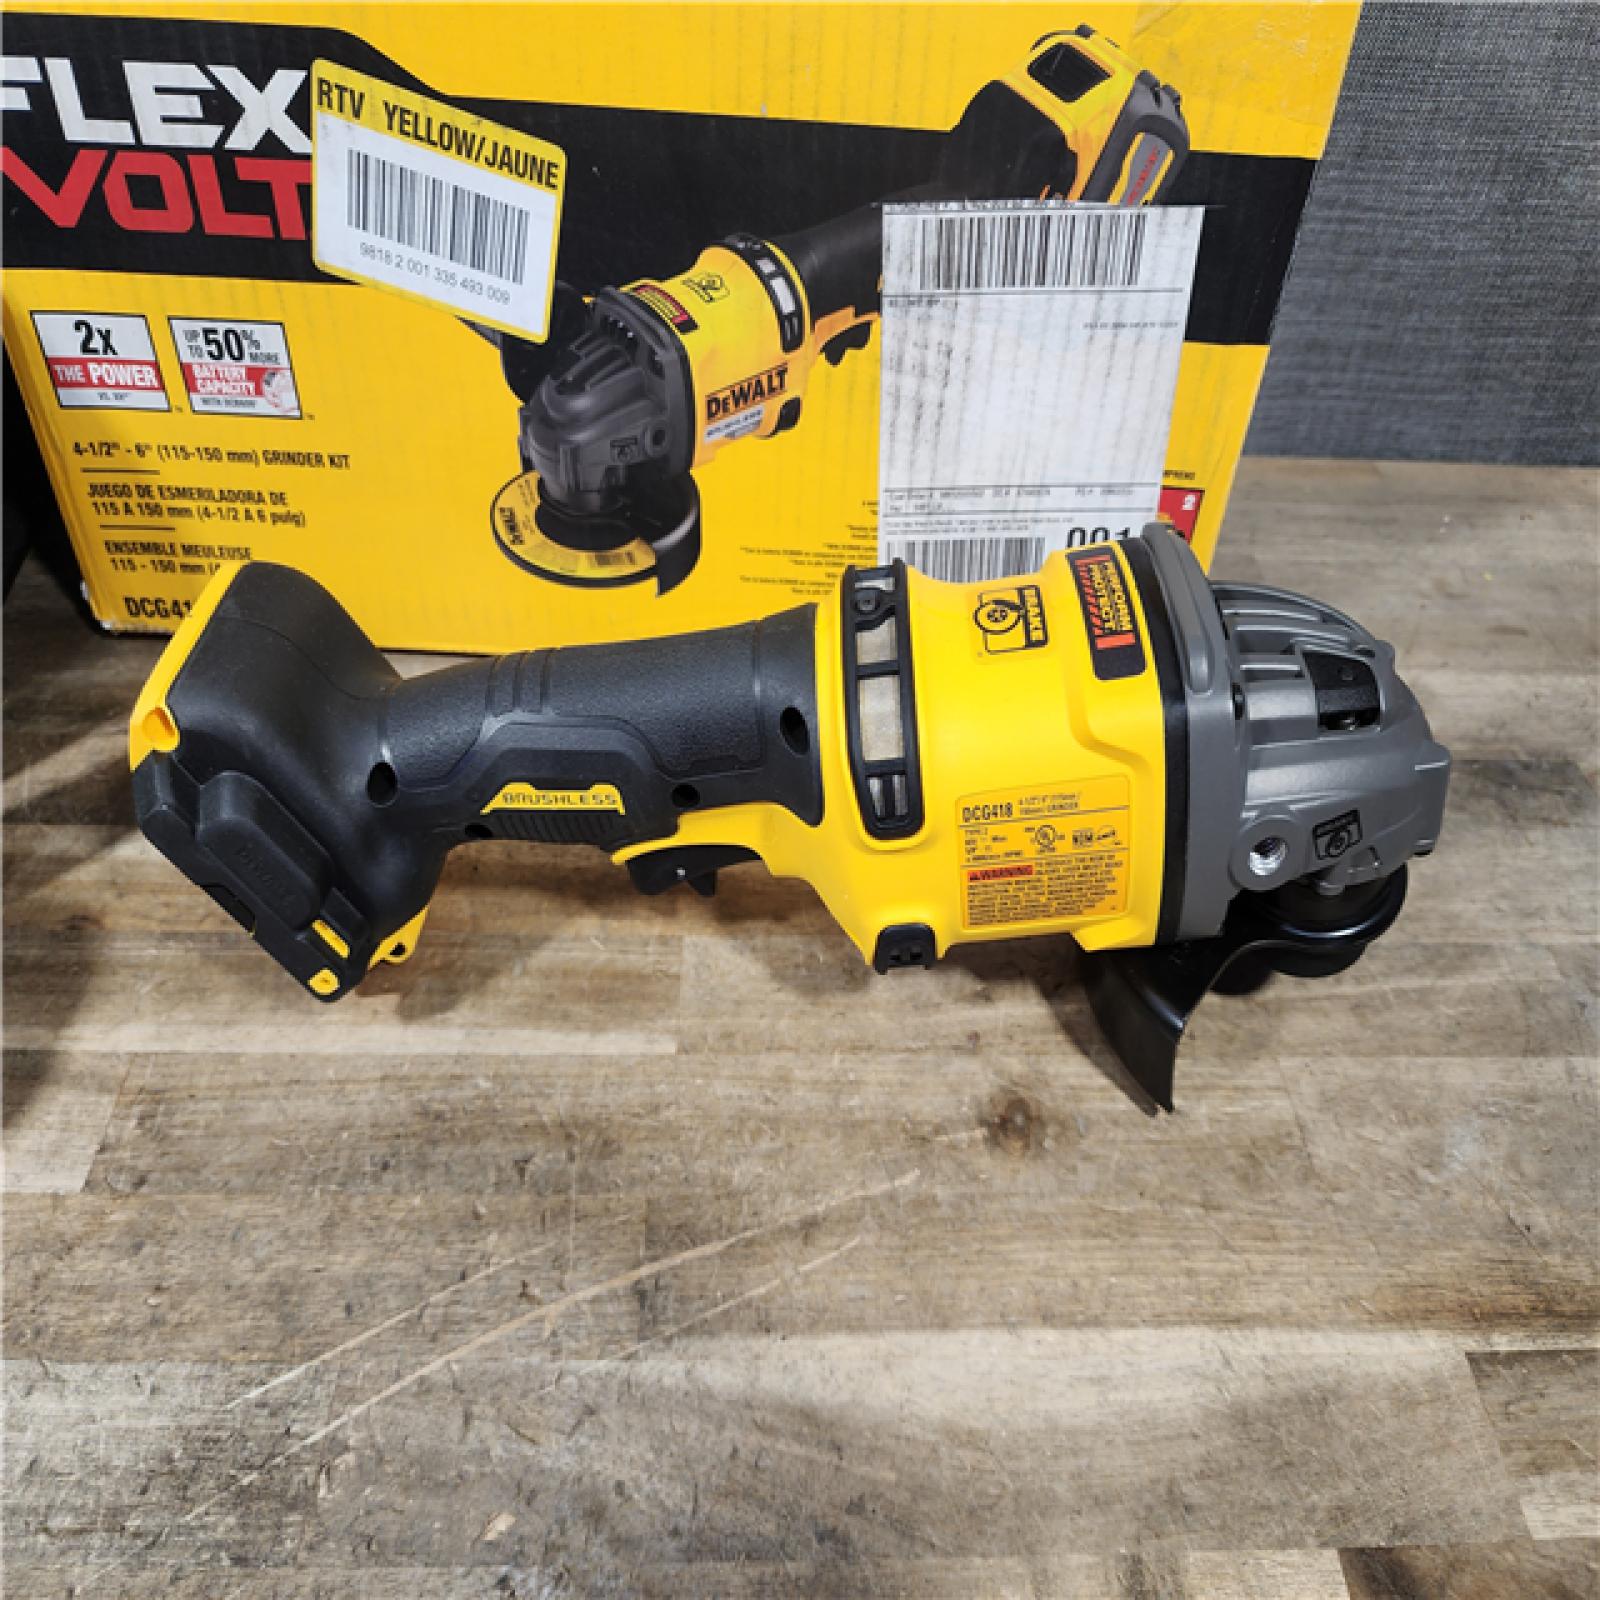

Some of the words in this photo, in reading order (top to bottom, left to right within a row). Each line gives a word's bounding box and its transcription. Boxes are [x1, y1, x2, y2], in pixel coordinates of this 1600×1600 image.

[317, 77, 365, 120] RTV
[384, 99, 559, 190] YELLOW/JAUNE
[0, 146, 312, 240] VOLT
[54, 365, 86, 384] THE
[88, 363, 159, 388] POWER
[262, 450, 326, 468] GRINDER
[329, 454, 350, 469] KIT
[88, 483, 132, 498] JUEGO
[135, 484, 155, 499] DE
[157, 485, 265, 503] ESMERILADORA
[269, 491, 288, 506] DE
[92, 502, 120, 516] 115
[137, 503, 163, 517] 150
[167, 506, 193, 518] mm
[104, 540, 176, 557] ENSEMBLE
[180, 543, 252, 560] MEULEUSE
[111, 559, 137, 572] 115
[149, 560, 176, 573] 150
[180, 563, 205, 574] mm
[503, 792, 617, 806] BRUSHLESS
[962, 802, 1013, 822] DCG418
